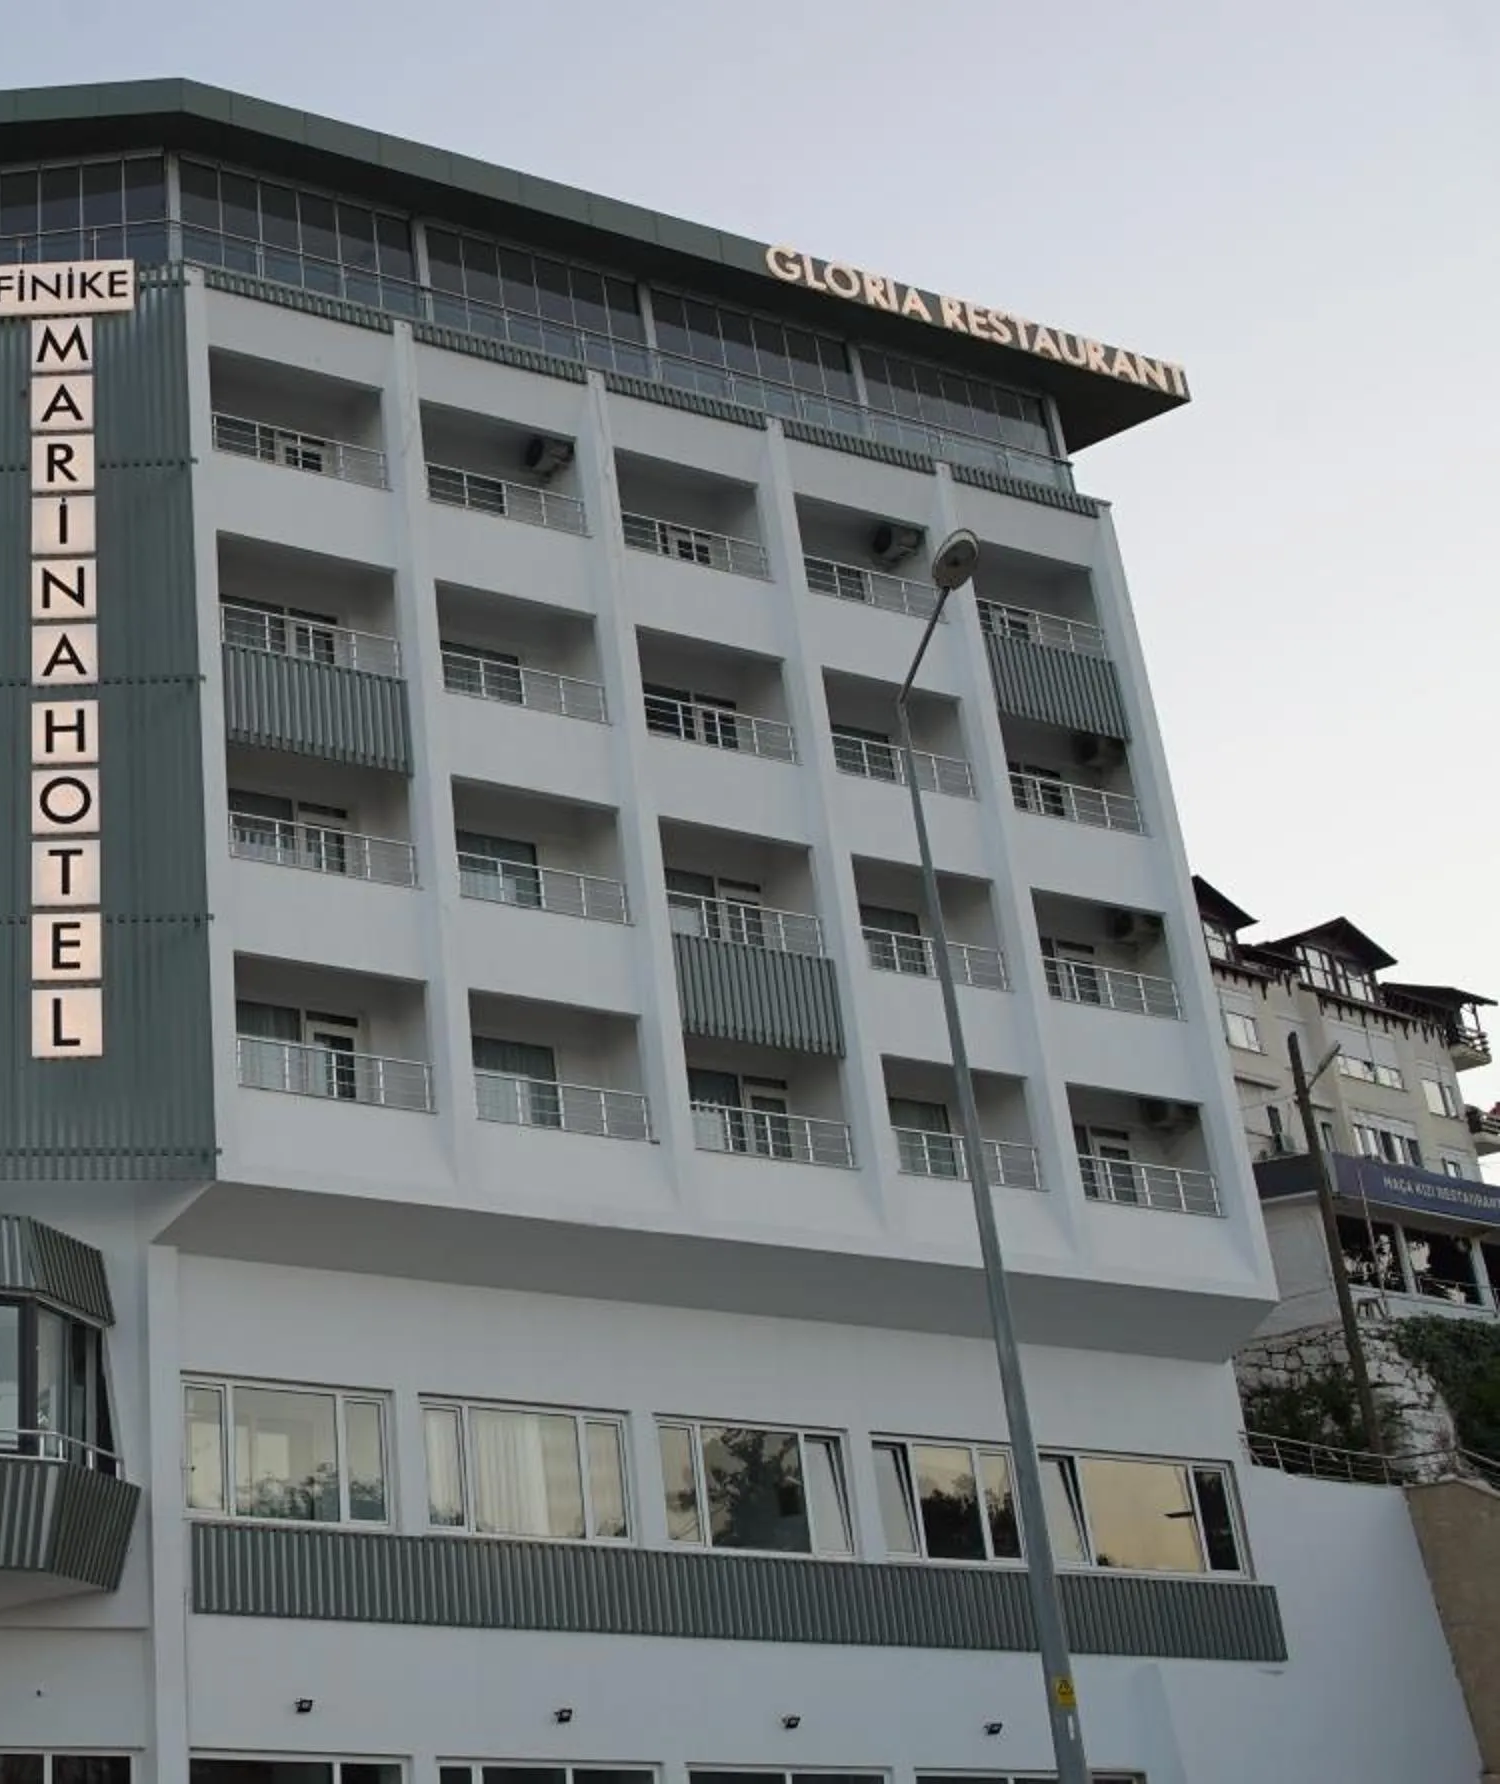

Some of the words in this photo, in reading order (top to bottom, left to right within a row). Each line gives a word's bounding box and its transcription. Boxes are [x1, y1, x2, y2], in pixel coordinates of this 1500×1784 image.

[765, 245, 932, 321] GLORIA
[940, 296, 1188, 396] RESTAURANT
[36, 323, 90, 676] MARİNA
[38, 708, 92, 1047] HOTEL
